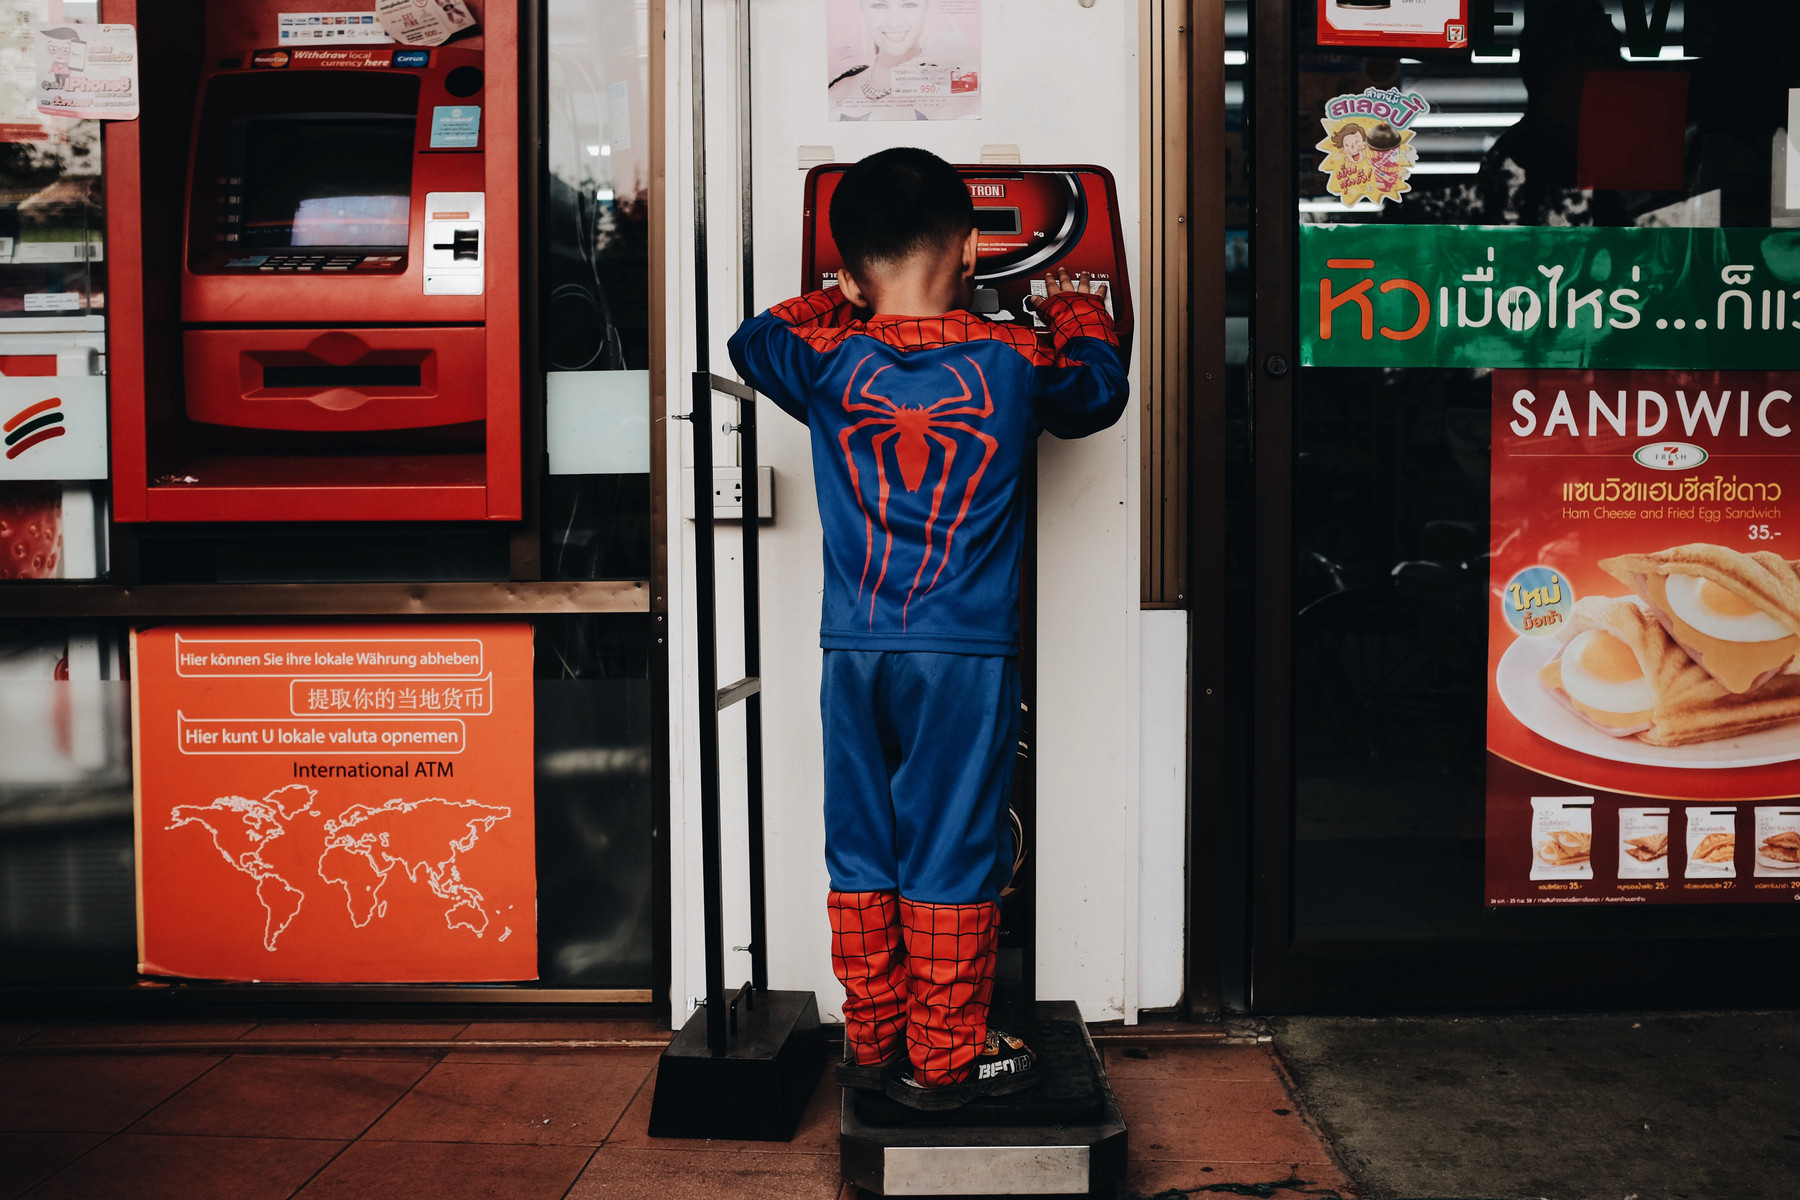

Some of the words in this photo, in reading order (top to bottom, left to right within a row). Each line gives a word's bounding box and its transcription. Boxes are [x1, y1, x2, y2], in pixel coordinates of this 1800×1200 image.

[294, 51, 348, 59] Withdraw
[349, 51, 372, 59] local
[320, 60, 363, 68] currency
[364, 59, 390, 67] here
[970, 185, 1000, 196] TRON
[1509, 389, 1793, 437] SANDWIC
[1563, 475, 1782, 501] แซนวิชแฮมชีสไข่ดาว
[1562, 507, 1590, 519] Ham
[1593, 506, 1637, 519] Cheese
[1640, 506, 1663, 519] and
[1667, 506, 1695, 519] Fried
[1698, 507, 1721, 522] Egg
[1725, 506, 1781, 519] Sandwich
[1748, 524, 1782, 540] 35.-
[1509, 575, 1561, 611] ใหม่
[1523, 609, 1563, 631] มื้อเช้า
[180, 654, 207, 666] Hier
[211, 653, 260, 666] können
[264, 653, 283, 666] Sie
[287, 653, 311, 666] ihre
[315, 652, 354, 665] lokale
[356, 652, 417, 668] Währung
[420, 652, 479, 665] abheben
[308, 687, 484, 710] 提取你的当地货币
[186, 729, 218, 744] Hier
[222, 729, 258, 744] kunt
[262, 729, 274, 744] U
[278, 729, 325, 744] lokale
[329, 728, 376, 743] valuta
[381, 731, 458, 746] opnemen
[293, 762, 408, 778] International
[414, 762, 454, 778] ATM
[1569, 881, 1584, 890] 35.-
[1655, 881, 1670, 890] 25.-
[1723, 881, 1737, 889] 27.-
